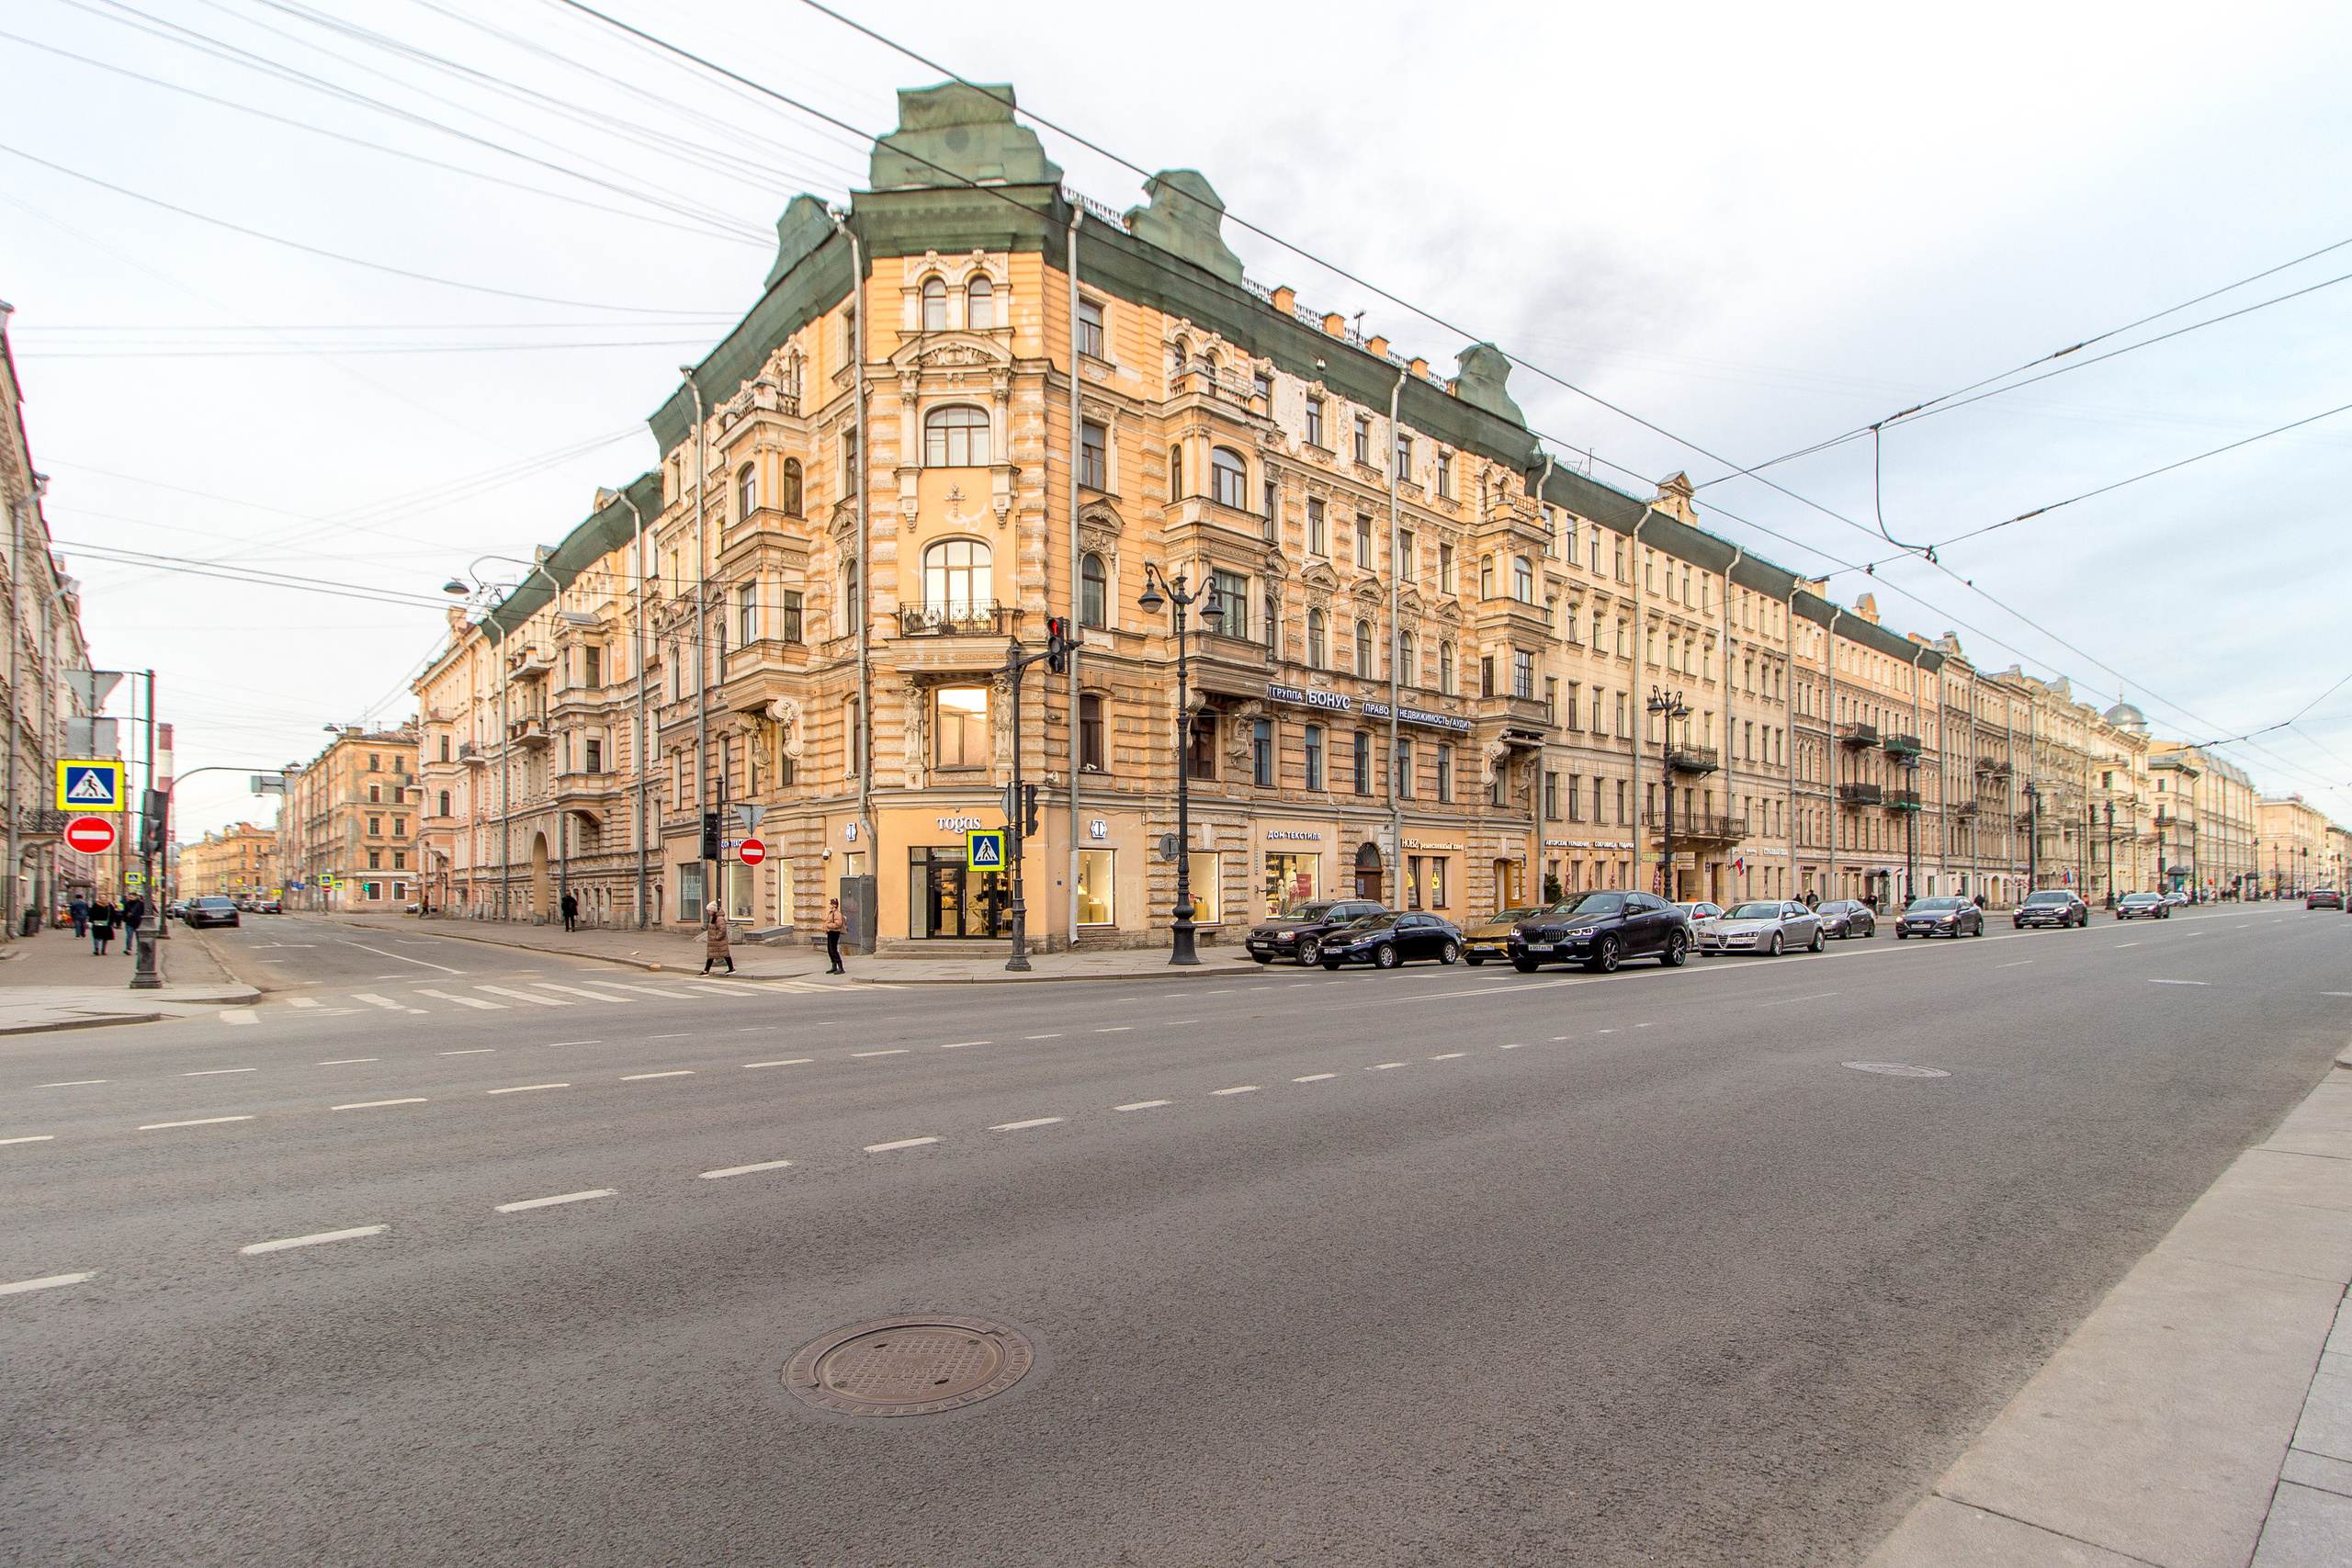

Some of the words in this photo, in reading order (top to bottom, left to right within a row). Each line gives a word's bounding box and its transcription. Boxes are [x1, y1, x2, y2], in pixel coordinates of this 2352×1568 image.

[1272, 687, 1303, 701] ГРУППА
[1308, 690, 1351, 710] БОНУС
[1365, 703, 1389, 716] ПРАВО
[1268, 830, 1285, 840] ДОМ
[1286, 831, 1322, 840] ТЕКСТИЛЯ
